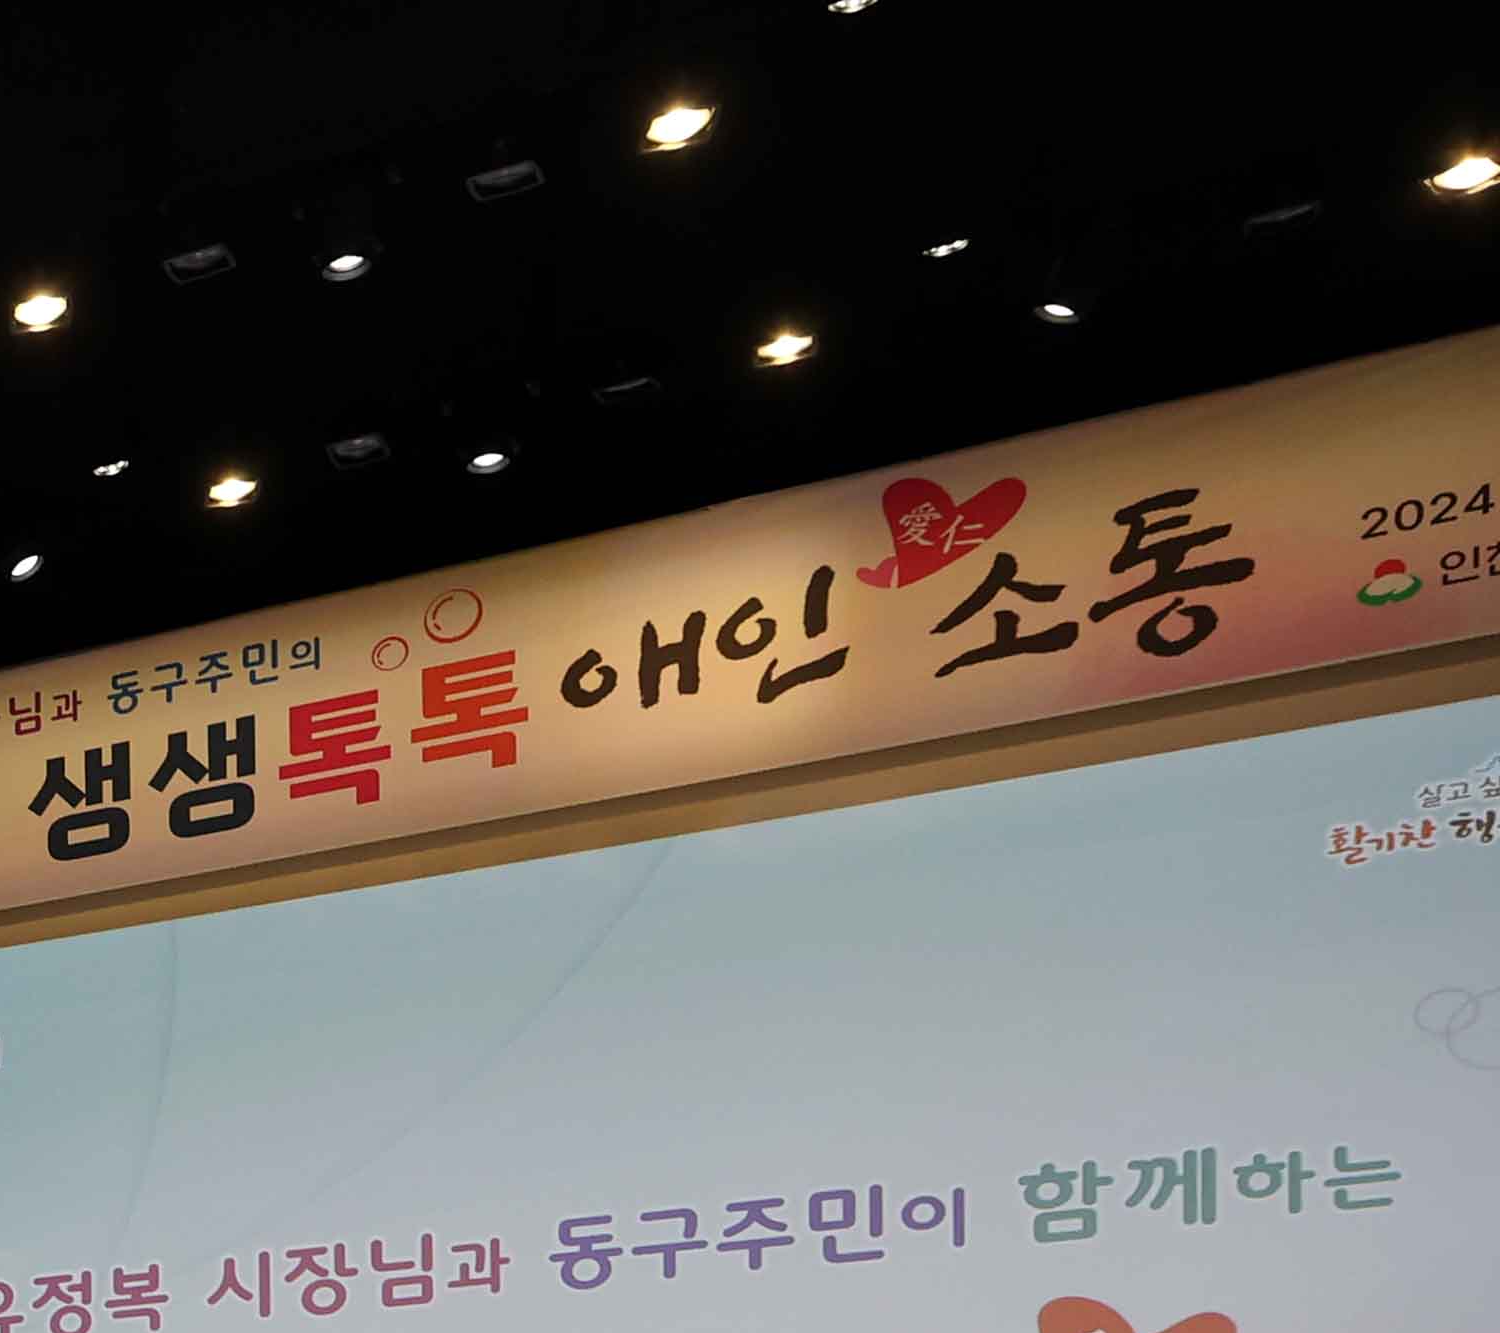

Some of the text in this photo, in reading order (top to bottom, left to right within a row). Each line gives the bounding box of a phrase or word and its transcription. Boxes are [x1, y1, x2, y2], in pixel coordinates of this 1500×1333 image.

[1360, 483, 1495, 540] 2024
[27, 488, 1255, 862] 생생톡톡 애인 소통
[107, 637, 323, 716] 동구주민의
[1327, 819, 1436, 865] 활기찬
[206, 1233, 510, 1319] 시장님과
[549, 1184, 969, 1292] 동구주민이
[1019, 1145, 1403, 1243] 함께하는
